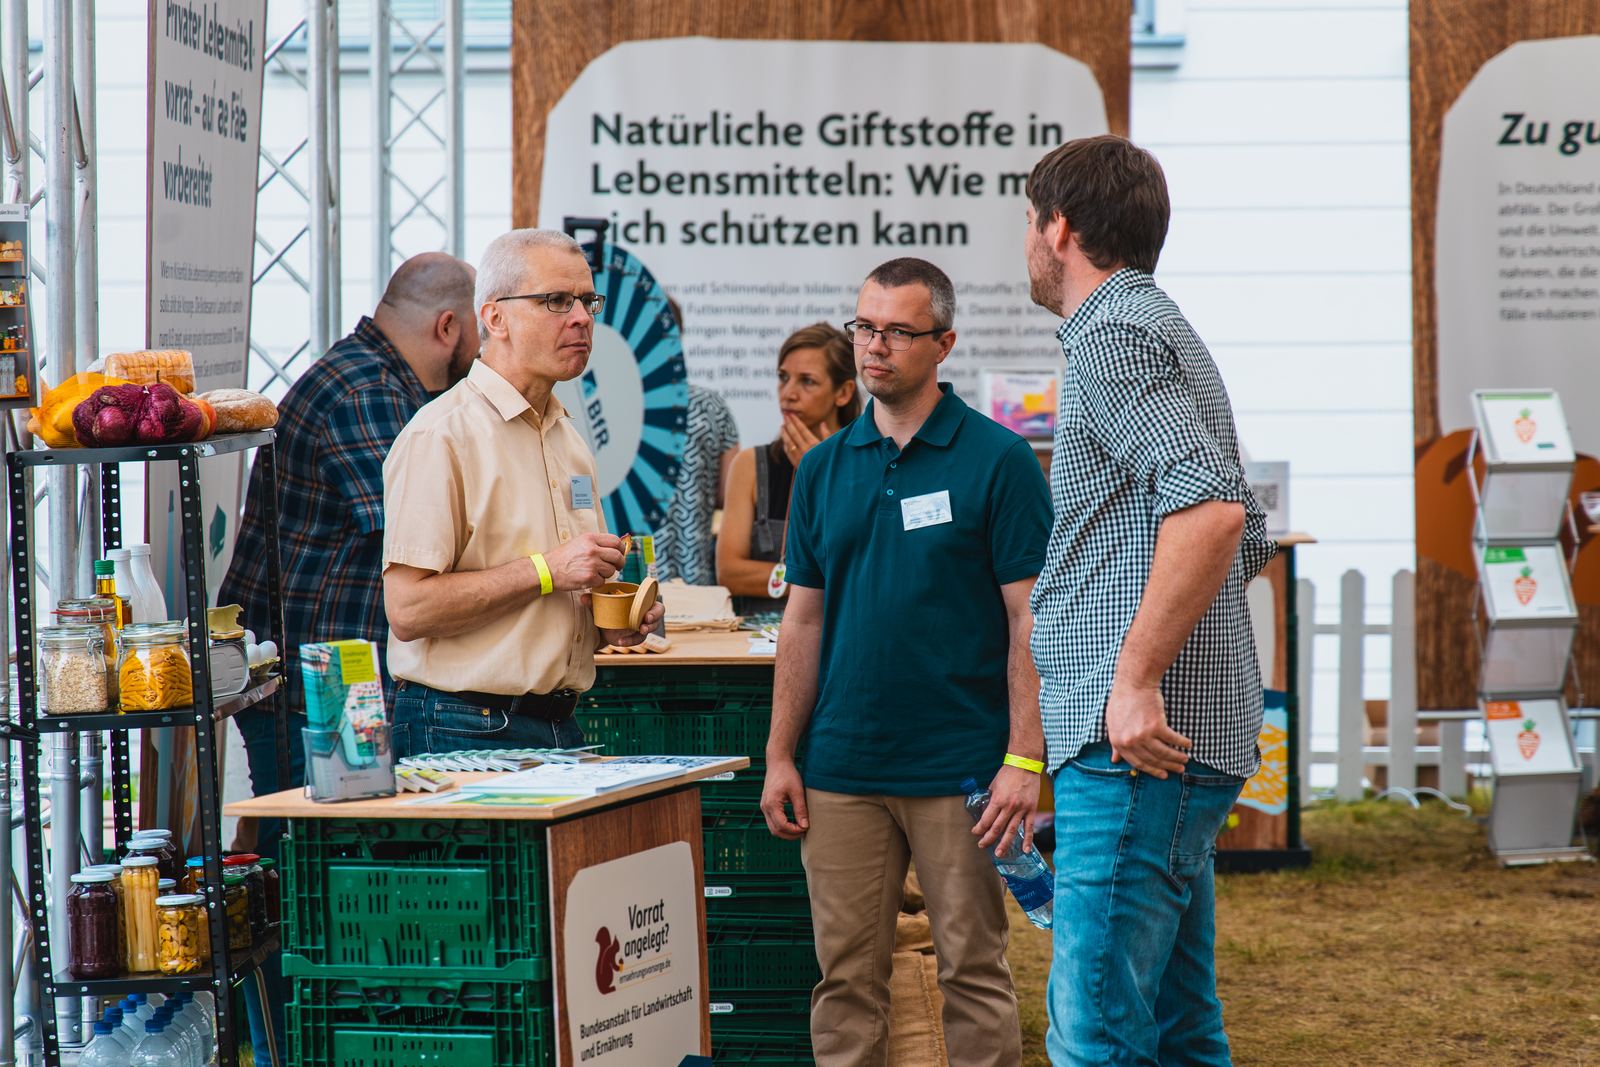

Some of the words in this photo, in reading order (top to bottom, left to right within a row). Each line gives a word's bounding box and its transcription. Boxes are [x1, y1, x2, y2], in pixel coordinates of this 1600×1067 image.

[592, 110, 804, 146] Natürliche
[818, 111, 1015, 147] Giftstoffe
[1028, 113, 1063, 146] in
[1498, 111, 1549, 146] Zu
[592, 159, 893, 196] Lebensmitteln:
[907, 163, 985, 196] Wie
[610, 209, 666, 244] ich
[681, 209, 859, 246] schützen
[873, 210, 969, 246] kann
[628, 898, 665, 931] Vorrat
[624, 923, 670, 960] angelegt?
[579, 1007, 631, 1041] Bundesanstalt
[631, 1004, 642, 1022] für
[643, 985, 694, 1017] Landwirtschaft
[580, 1040, 596, 1062] und
[596, 1032, 634, 1057] Ernährung
